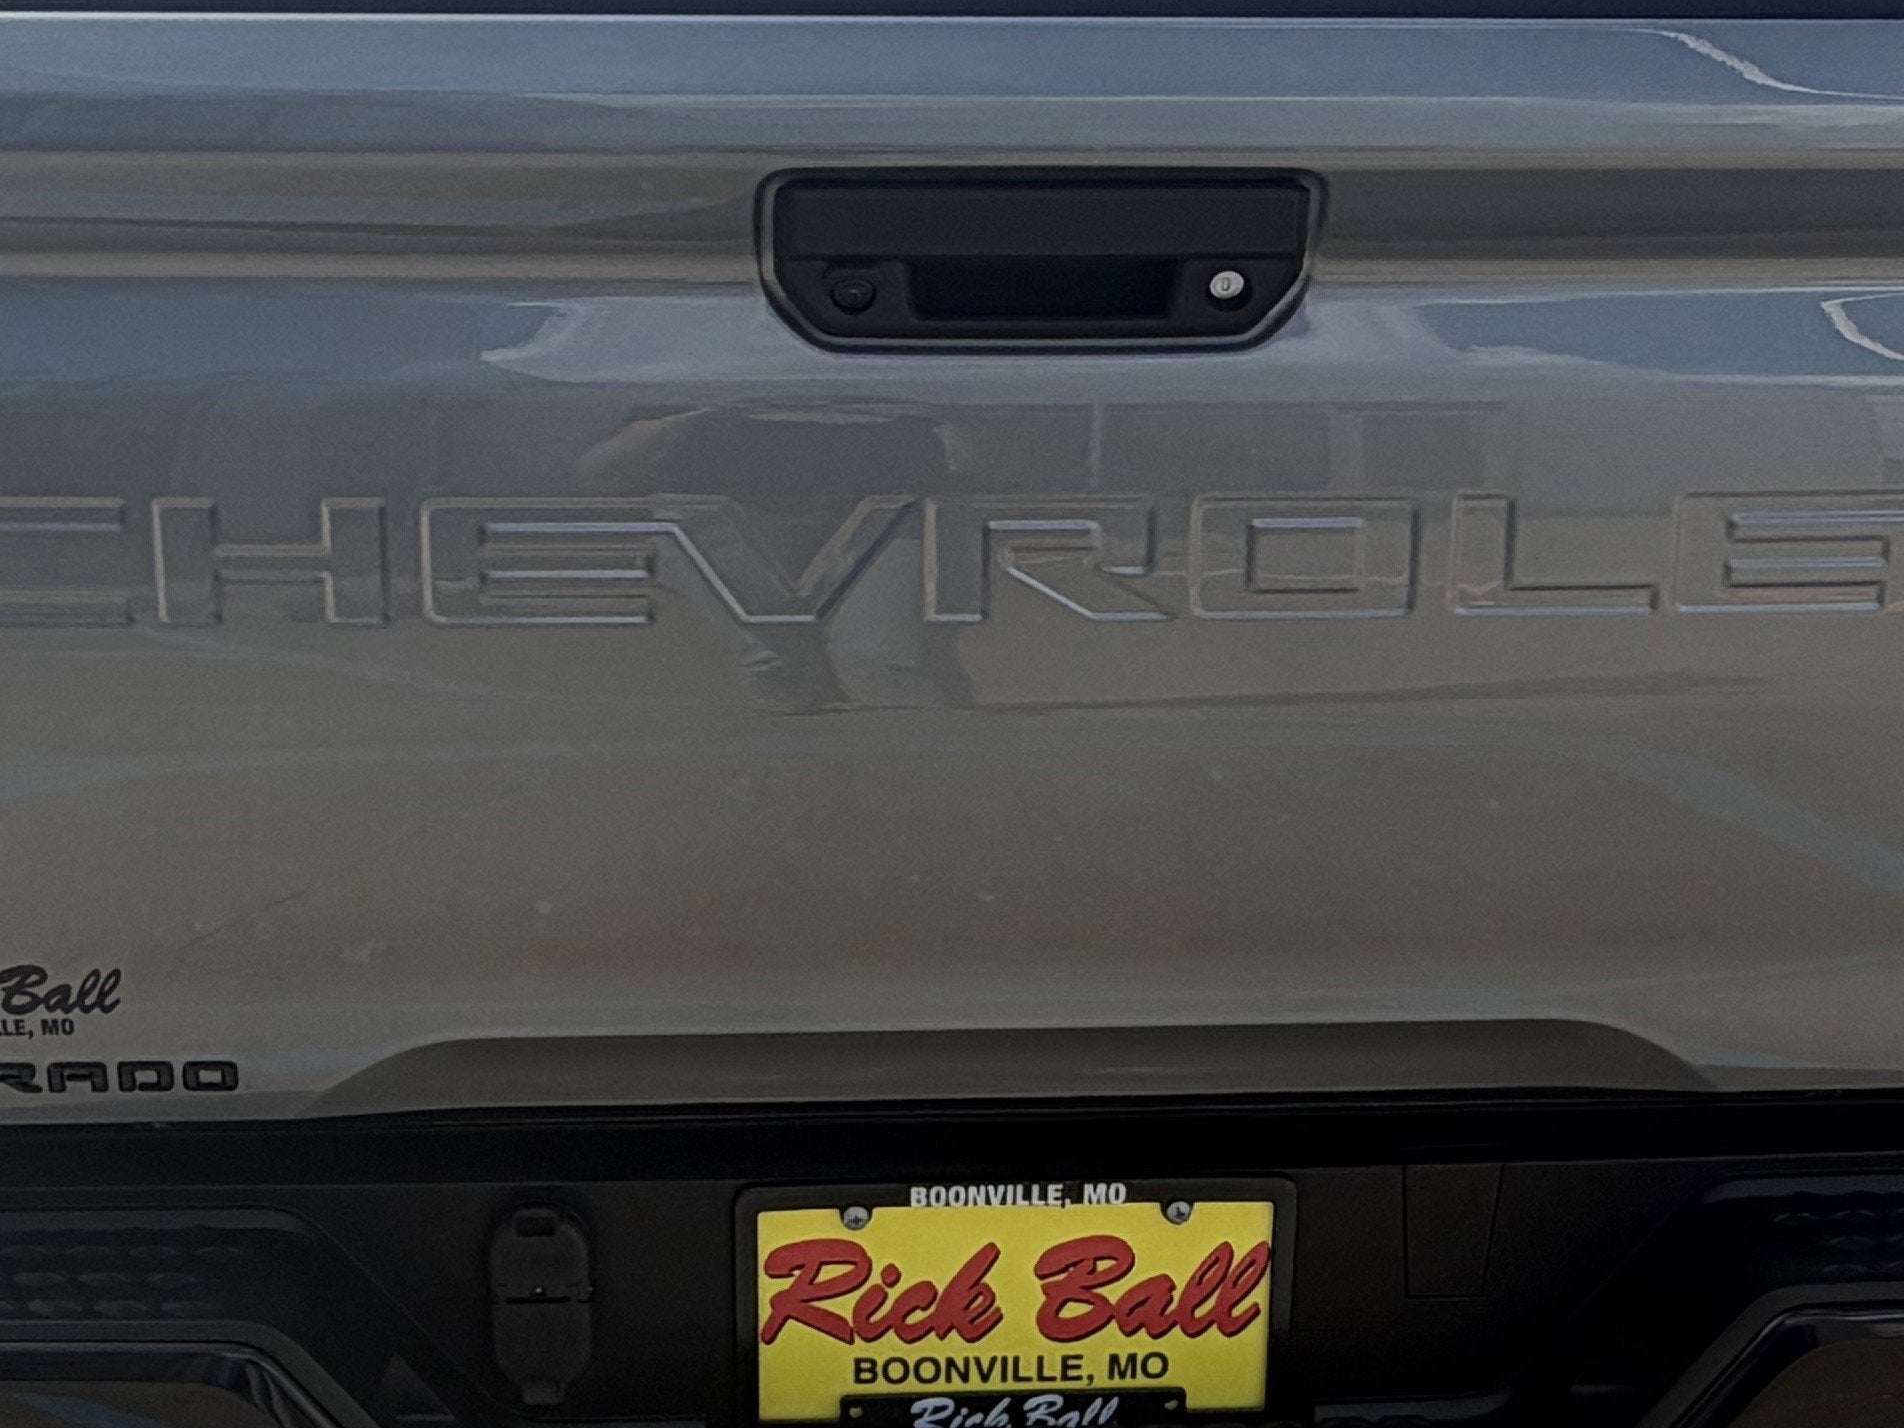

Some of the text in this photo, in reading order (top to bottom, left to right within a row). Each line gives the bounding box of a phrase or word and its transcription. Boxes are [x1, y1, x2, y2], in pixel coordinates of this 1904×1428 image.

[40, 1018, 75, 1037] MO
[910, 1182, 1128, 1209] BOONVILLE, MO
[760, 1235, 1271, 1345] Rick Ball
[853, 1352, 1170, 1386] BOONVILLE, MO
